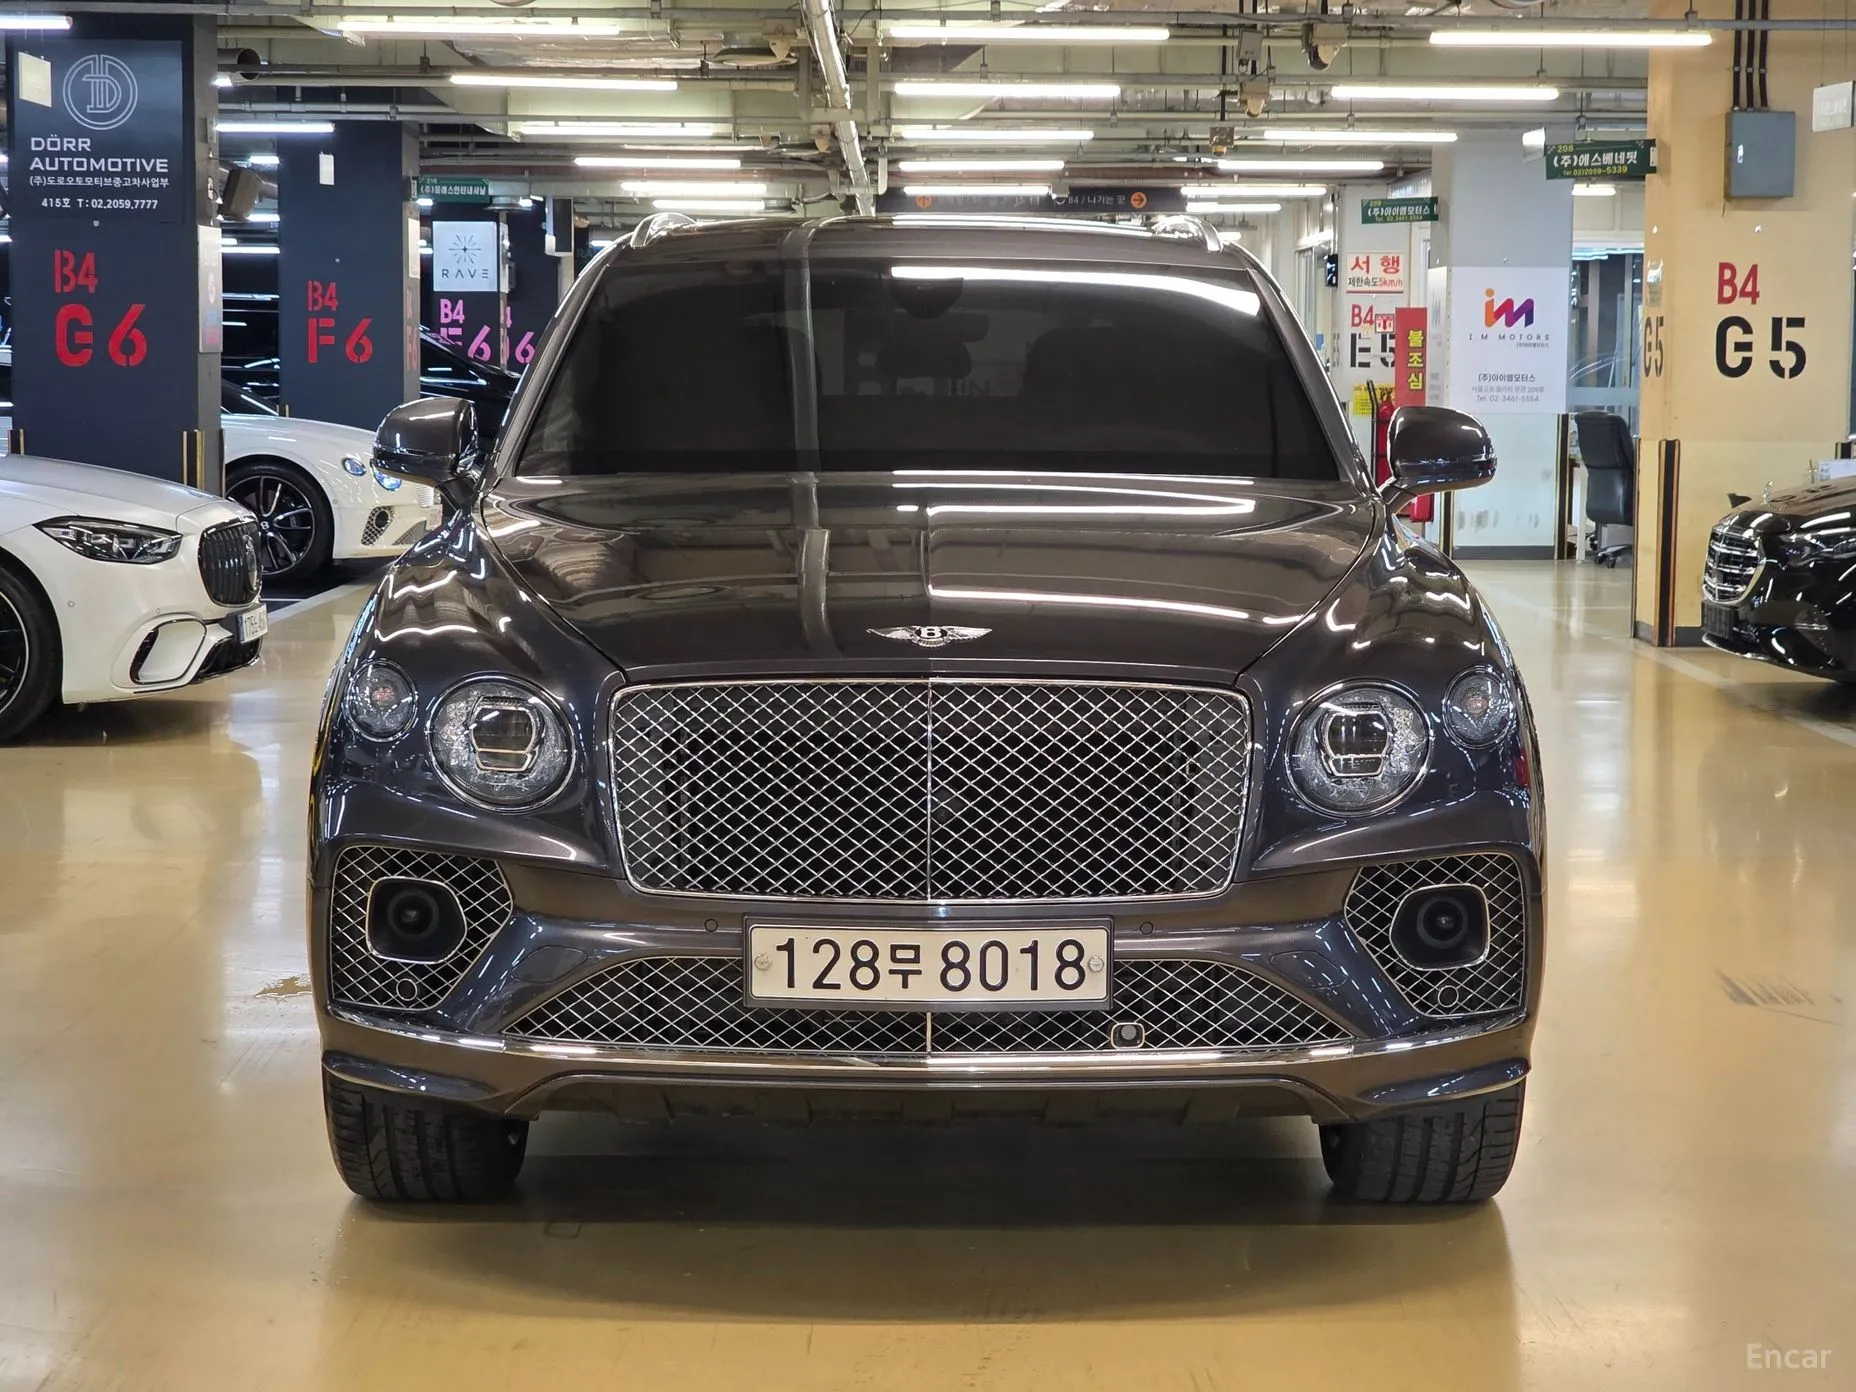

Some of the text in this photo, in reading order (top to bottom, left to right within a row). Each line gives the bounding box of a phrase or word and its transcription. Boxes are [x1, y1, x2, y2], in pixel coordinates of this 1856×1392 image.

[30, 133, 92, 152] DÖRR
[29, 157, 169, 173] AUTOMOTIVE
[41, 198, 71, 208] 415호
[54, 249, 99, 294] B4
[1718, 261, 1760, 306] B4
[306, 280, 338, 312] B4
[440, 299, 465, 324] B4
[1351, 304, 1375, 328] B4
[1498, 333, 1550, 341] MOTORS
